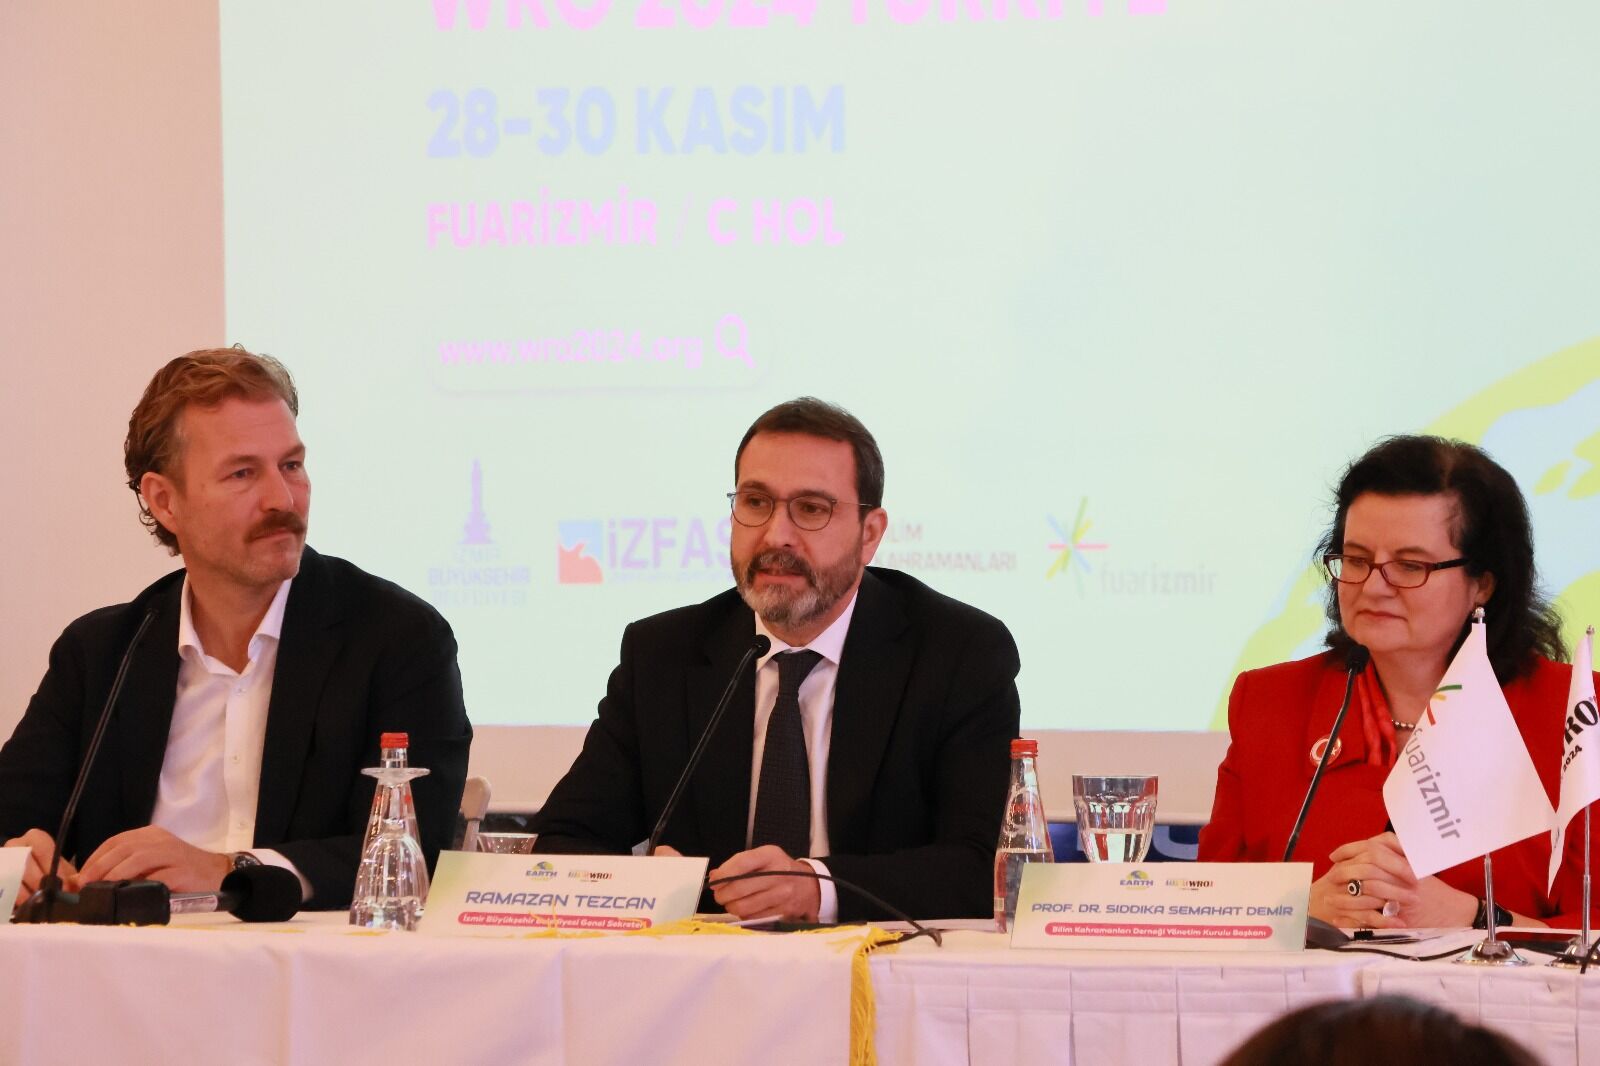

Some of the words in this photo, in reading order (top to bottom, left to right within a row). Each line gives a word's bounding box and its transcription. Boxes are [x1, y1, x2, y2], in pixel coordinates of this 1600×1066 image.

[427, 87, 617, 158] 28-30
[636, 85, 846, 155] KASIM
[427, 185, 659, 249] FUARİZMİR
[707, 198, 739, 247] C
[752, 196, 846, 247] HOL
[438, 328, 703, 368] www.wro2024.org
[1100, 561, 1220, 594] fuarizmir
[1563, 700, 1599, 745] RO
[465, 891, 569, 906] RAMAZAN
[574, 895, 656, 910] TEZCAN
[1031, 903, 1075, 913] PROF.
[1079, 904, 1102, 914] DR.
[1106, 904, 1164, 914] SIDDIKA
[1168, 905, 1243, 915] SEMAHAT
[1247, 904, 1294, 916] DEMİR
